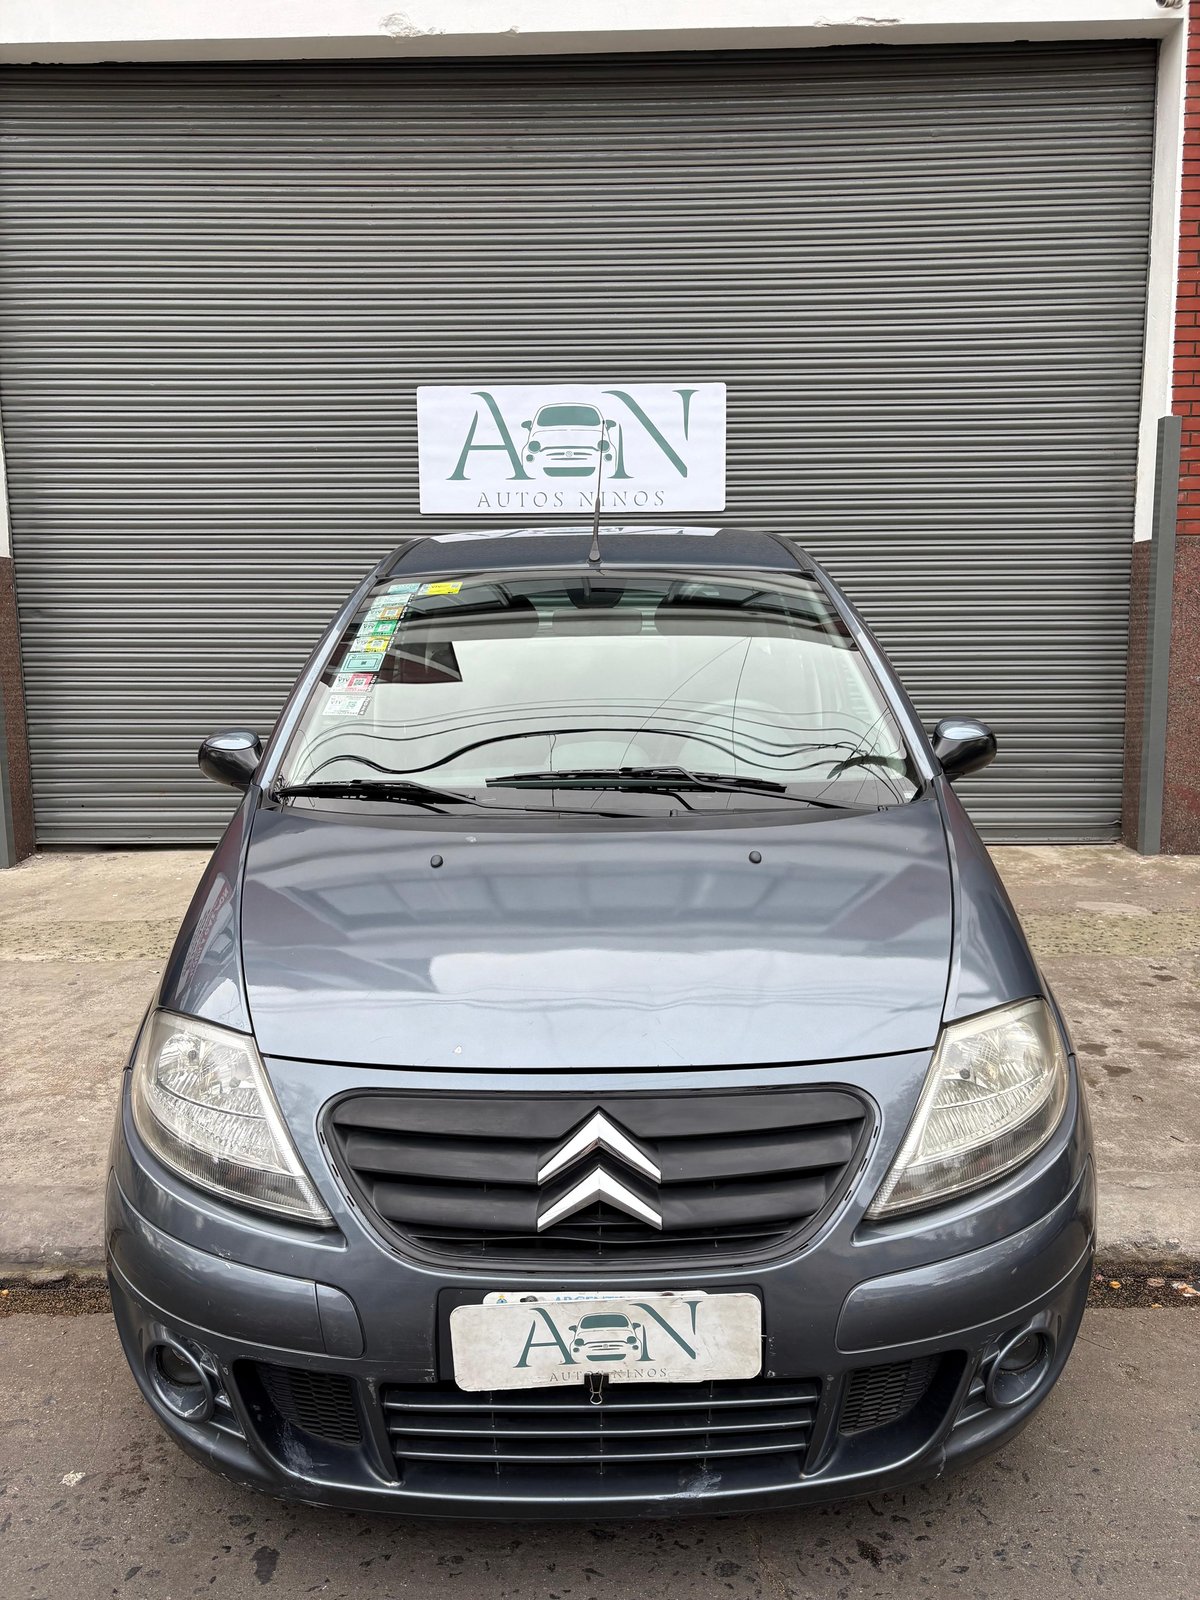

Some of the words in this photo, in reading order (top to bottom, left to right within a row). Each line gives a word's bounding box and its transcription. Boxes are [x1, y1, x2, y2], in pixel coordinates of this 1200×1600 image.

[477, 491, 564, 508] AUTOS
[579, 490, 665, 507] NINOS
[549, 1370, 604, 1382] AUT
[613, 1367, 667, 1379] NINOS
